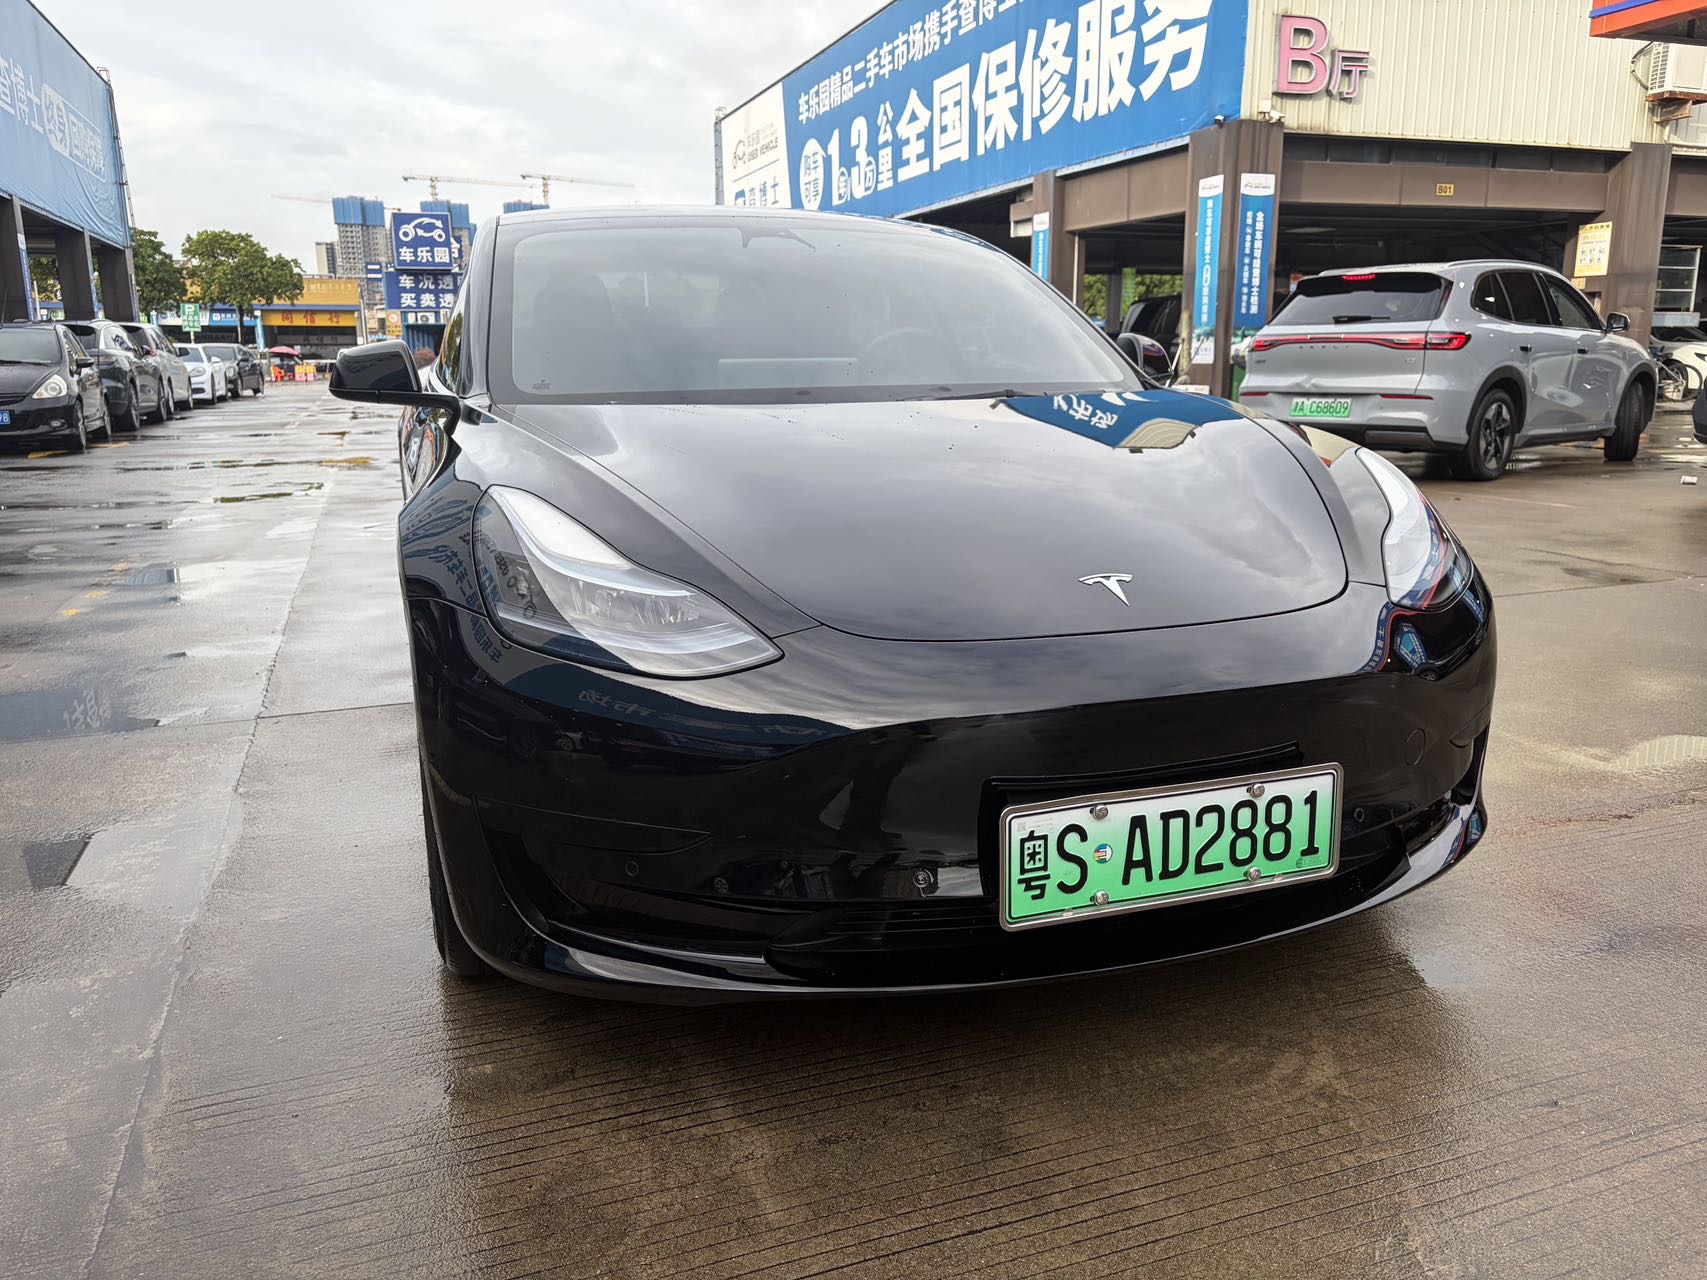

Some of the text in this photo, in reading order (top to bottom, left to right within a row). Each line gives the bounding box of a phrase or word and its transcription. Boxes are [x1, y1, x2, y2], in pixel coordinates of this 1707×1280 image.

[798, 0, 1024, 124] 车乐园精品二手车市场携手查博
[399, 246, 450, 263] 车乐园
[1121, 790, 1320, 886] AD2881
